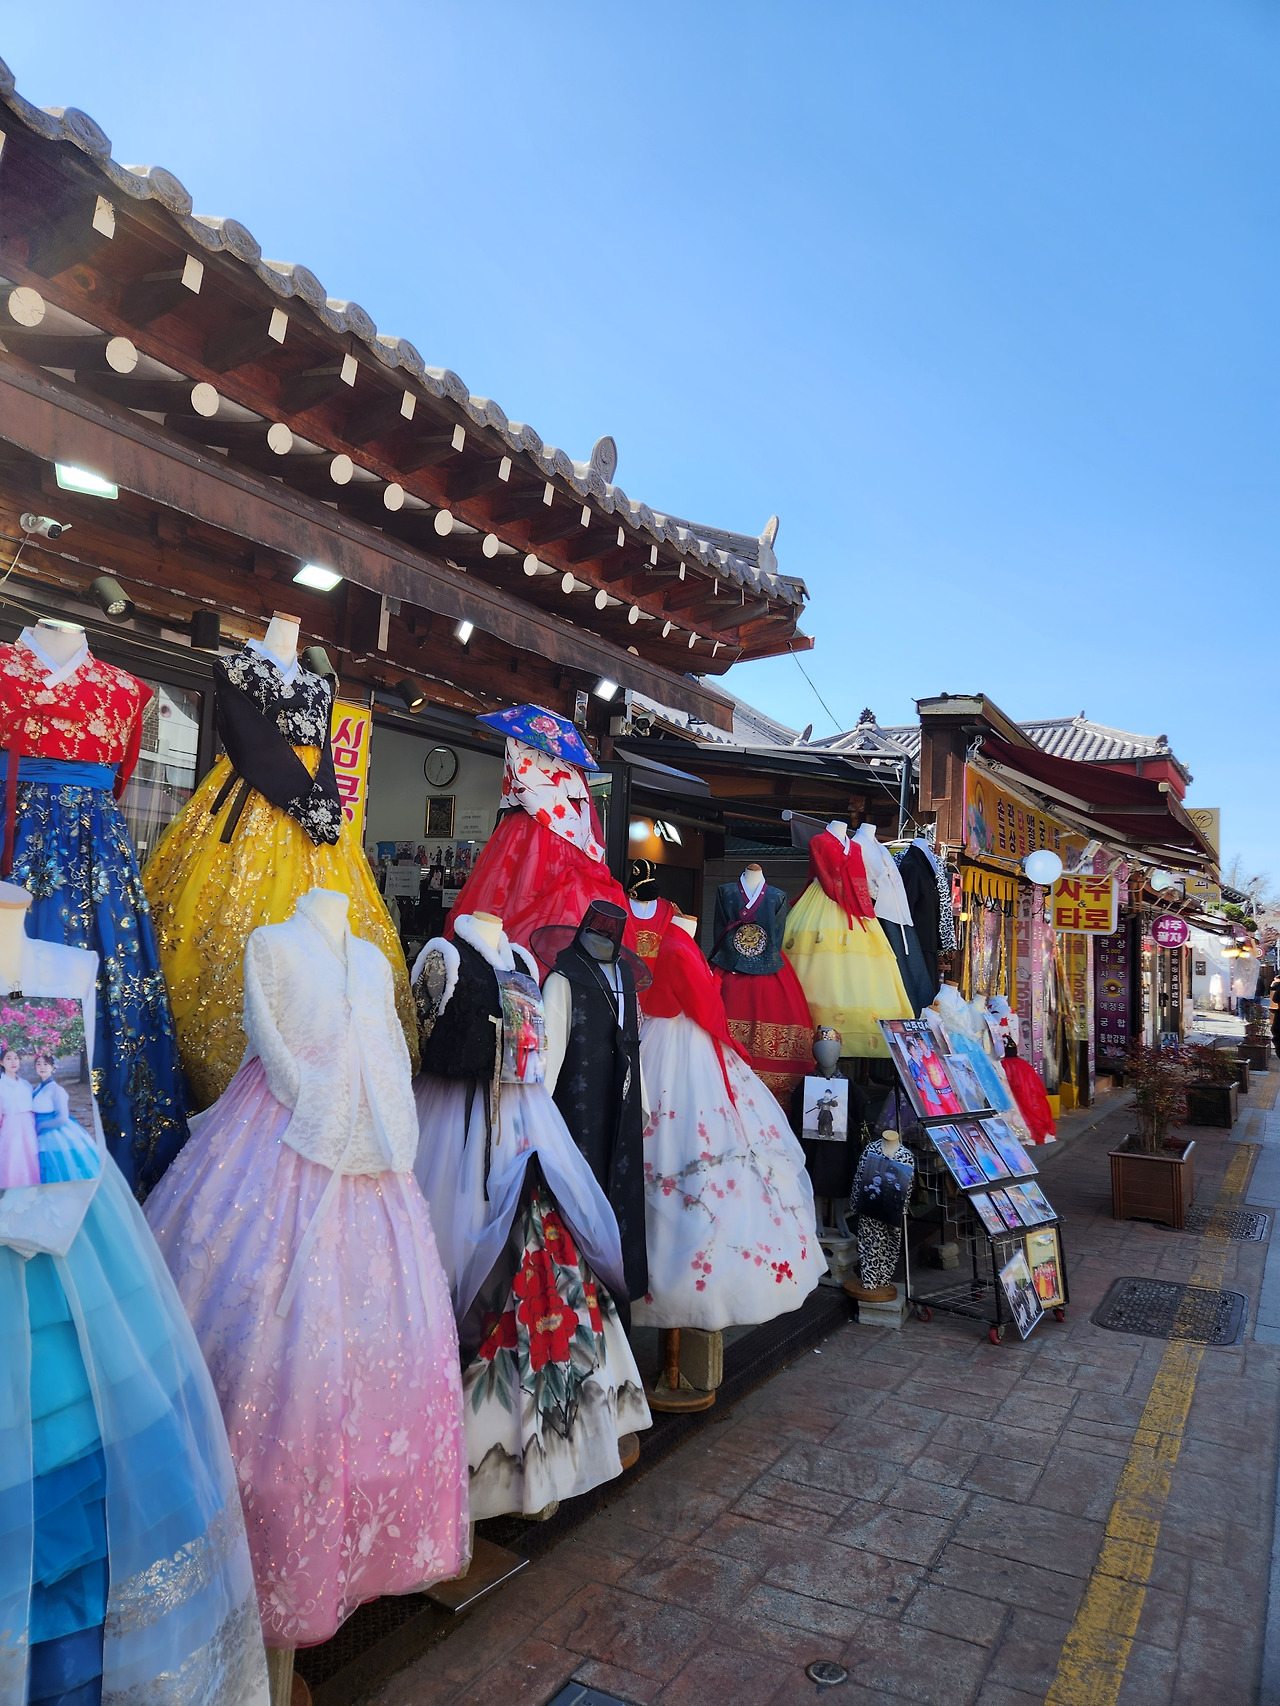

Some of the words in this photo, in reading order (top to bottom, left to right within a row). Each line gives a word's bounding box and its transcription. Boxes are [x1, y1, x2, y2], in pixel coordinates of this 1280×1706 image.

[1007, 803, 1016, 853] 관상
[1055, 877, 1110, 901] 사주
[1077, 900, 1087, 908] &
[1056, 908, 1110, 930] 타로
[1157, 920, 1182, 931] 사주
[1157, 931, 1182, 943] 팔자
[1100, 1001, 1126, 1012] 애정운
